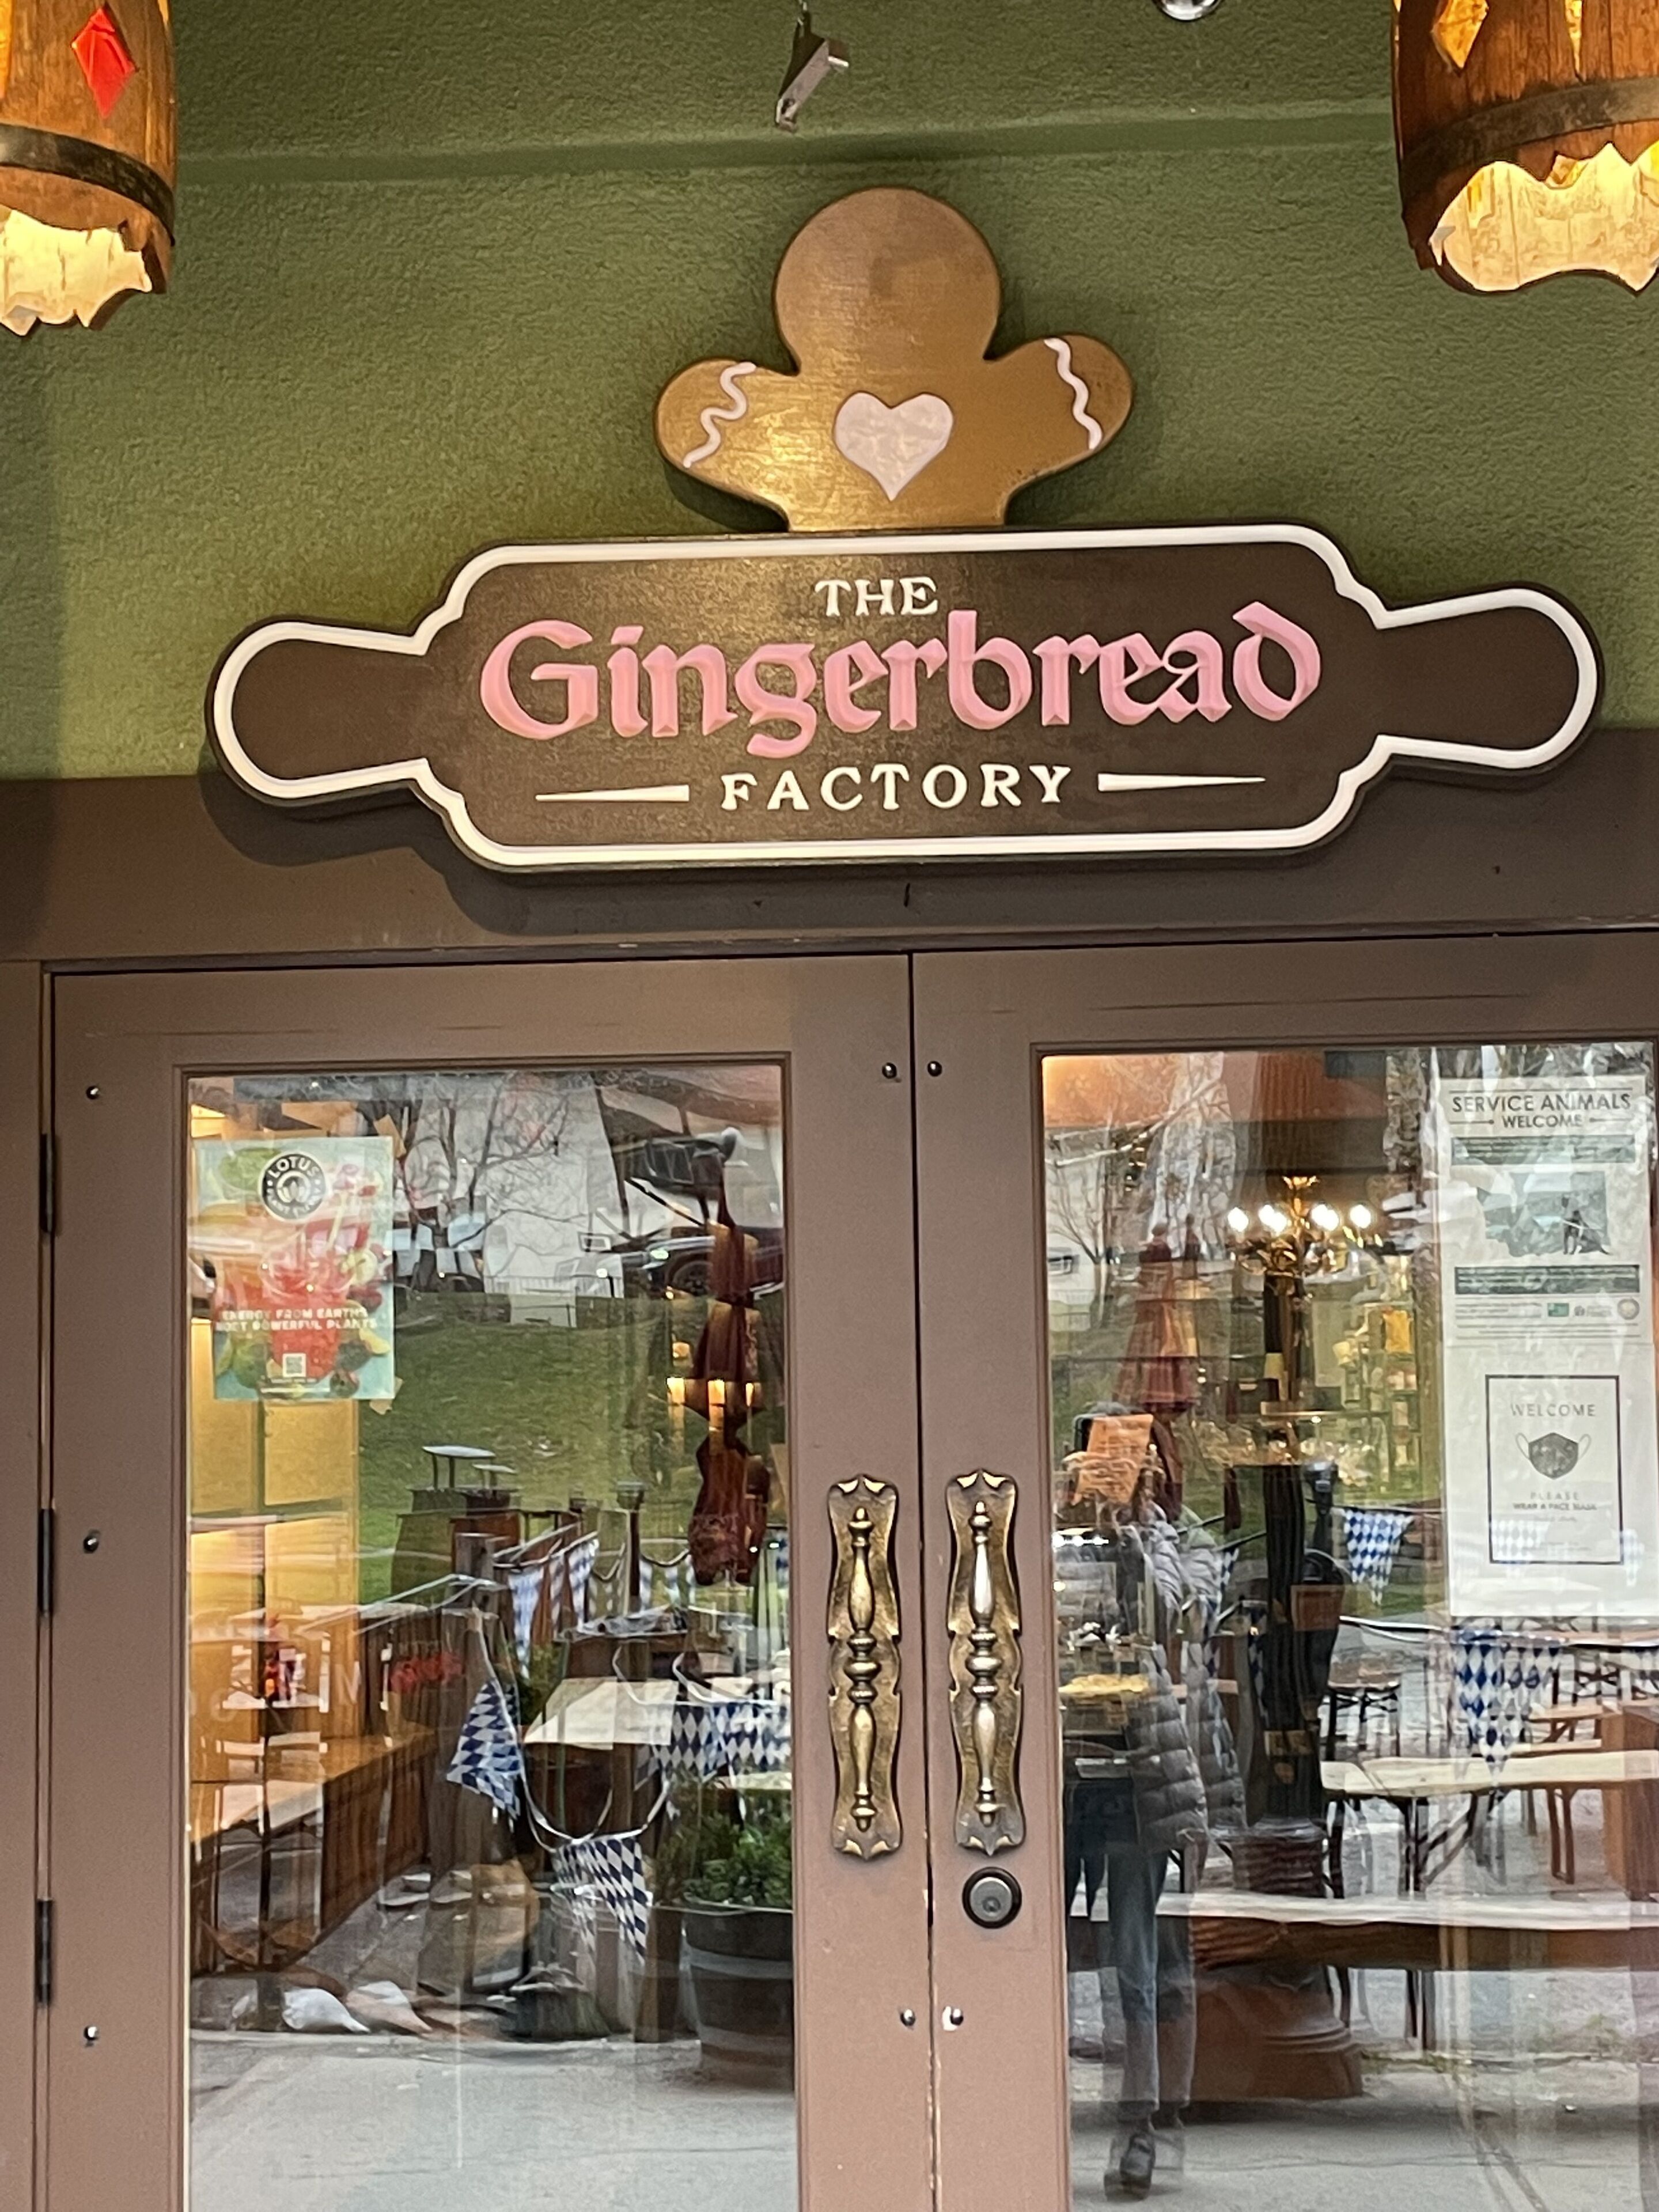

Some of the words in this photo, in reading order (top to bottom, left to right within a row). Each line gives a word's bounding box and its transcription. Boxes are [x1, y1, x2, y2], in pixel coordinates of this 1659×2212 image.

[815, 577, 938, 616] THE
[480, 601, 1321, 759] Gingerbread
[721, 764, 1071, 811] FACTORY
[1452, 1095, 1535, 1112] SERVICE
[1540, 1093, 1631, 1111] ANIMALS
[1502, 1113, 1583, 1128] WELCOME
[267, 1156, 321, 1179] LOTUS
[276, 1308, 313, 1319] FROM
[1510, 1403, 1596, 1417] WELCOME
